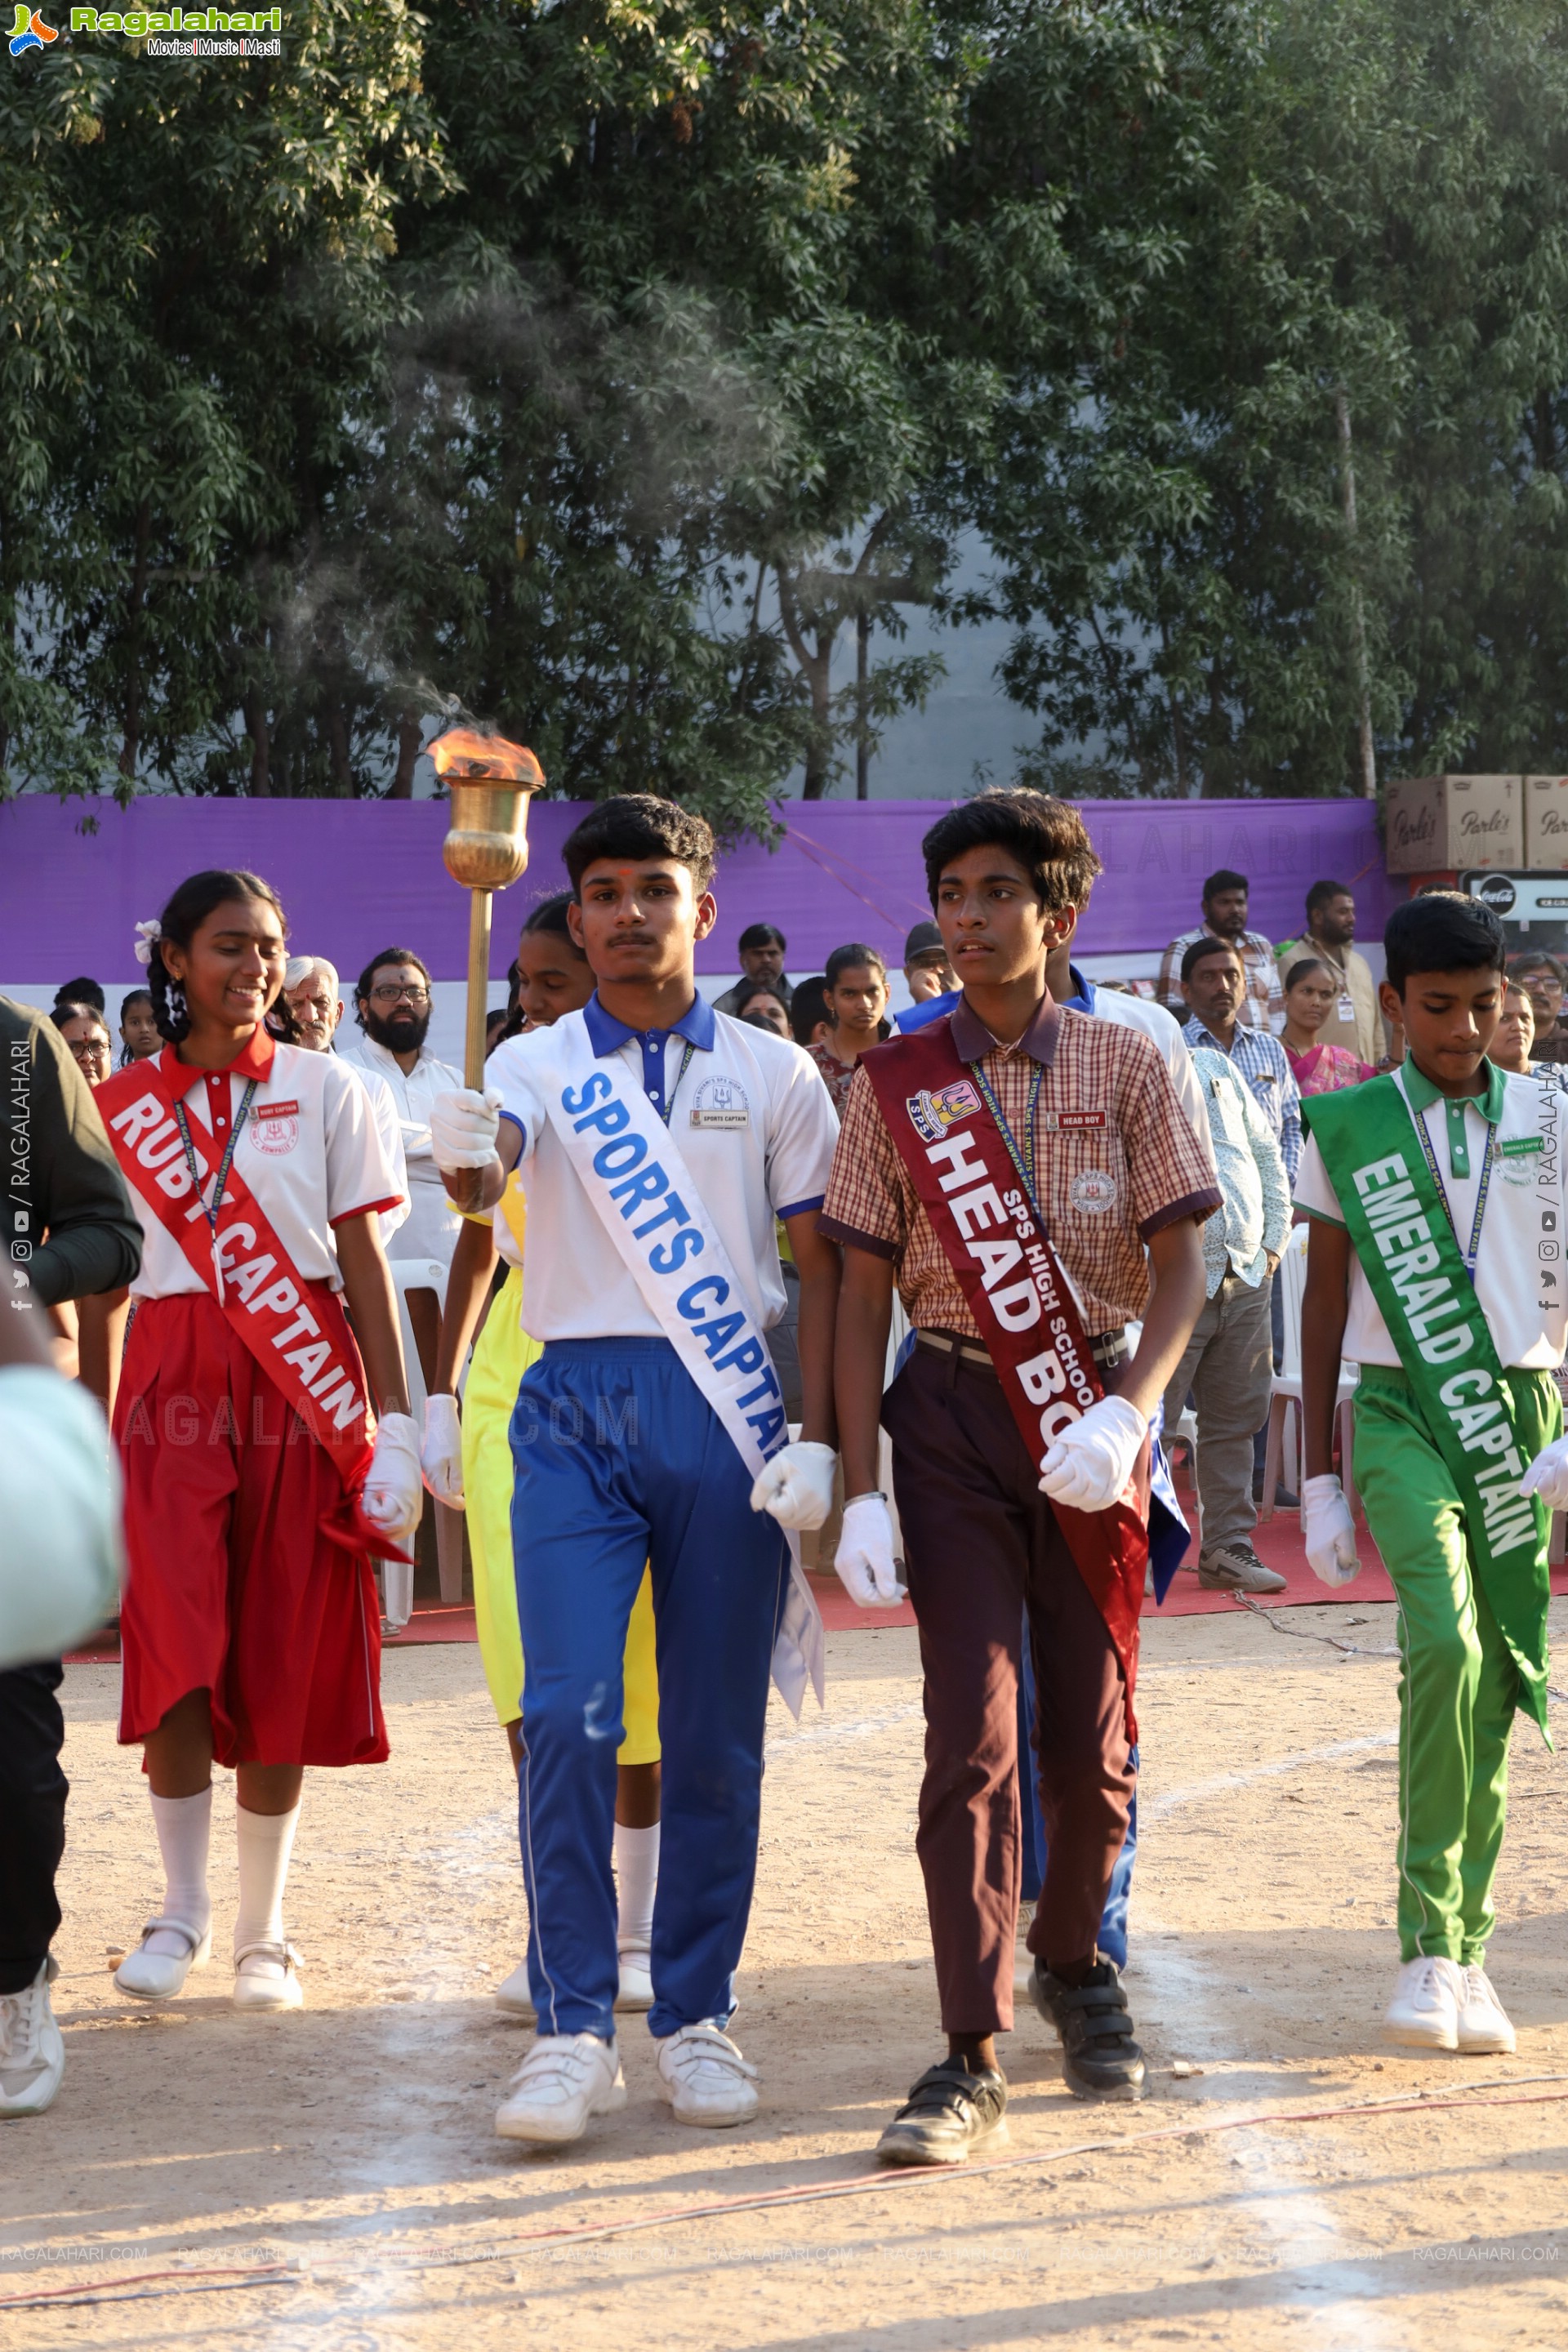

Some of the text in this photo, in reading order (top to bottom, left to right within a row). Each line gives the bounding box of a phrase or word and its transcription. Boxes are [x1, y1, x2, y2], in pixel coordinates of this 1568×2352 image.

[969, 1062, 986, 1088] SCHOO
[983, 1090, 997, 1114] HIGH
[1028, 1081, 1038, 1104] HIGH
[911, 1106, 929, 1134] SPS
[994, 1114, 1006, 1131] SPS
[1025, 1107, 1034, 1124] SPS
[1085, 1116, 1100, 1124] BOY
[212, 1186, 223, 1206] SIVA
[234, 1109, 246, 1130] HIGH
[242, 1080, 256, 1108] SCHOO
[1002, 1132, 1024, 1174] SIVANI'S
[1425, 1147, 1436, 1169] HIGH
[1481, 1170, 1490, 1187] SPS
[1474, 1189, 1486, 1228] SIVANI'S
[1470, 1230, 1479, 1253] SIVA
[109, 1092, 365, 1431] RUBY CAPTAIN
[561, 1071, 790, 1464] SPORTS CAPTAI
[925, 1130, 1083, 1450] HEAD BO
[1003, 1189, 1101, 1415] SPS HIGH SCHOO
[1352, 1153, 1538, 1558] EMERALD CAPTAIN
